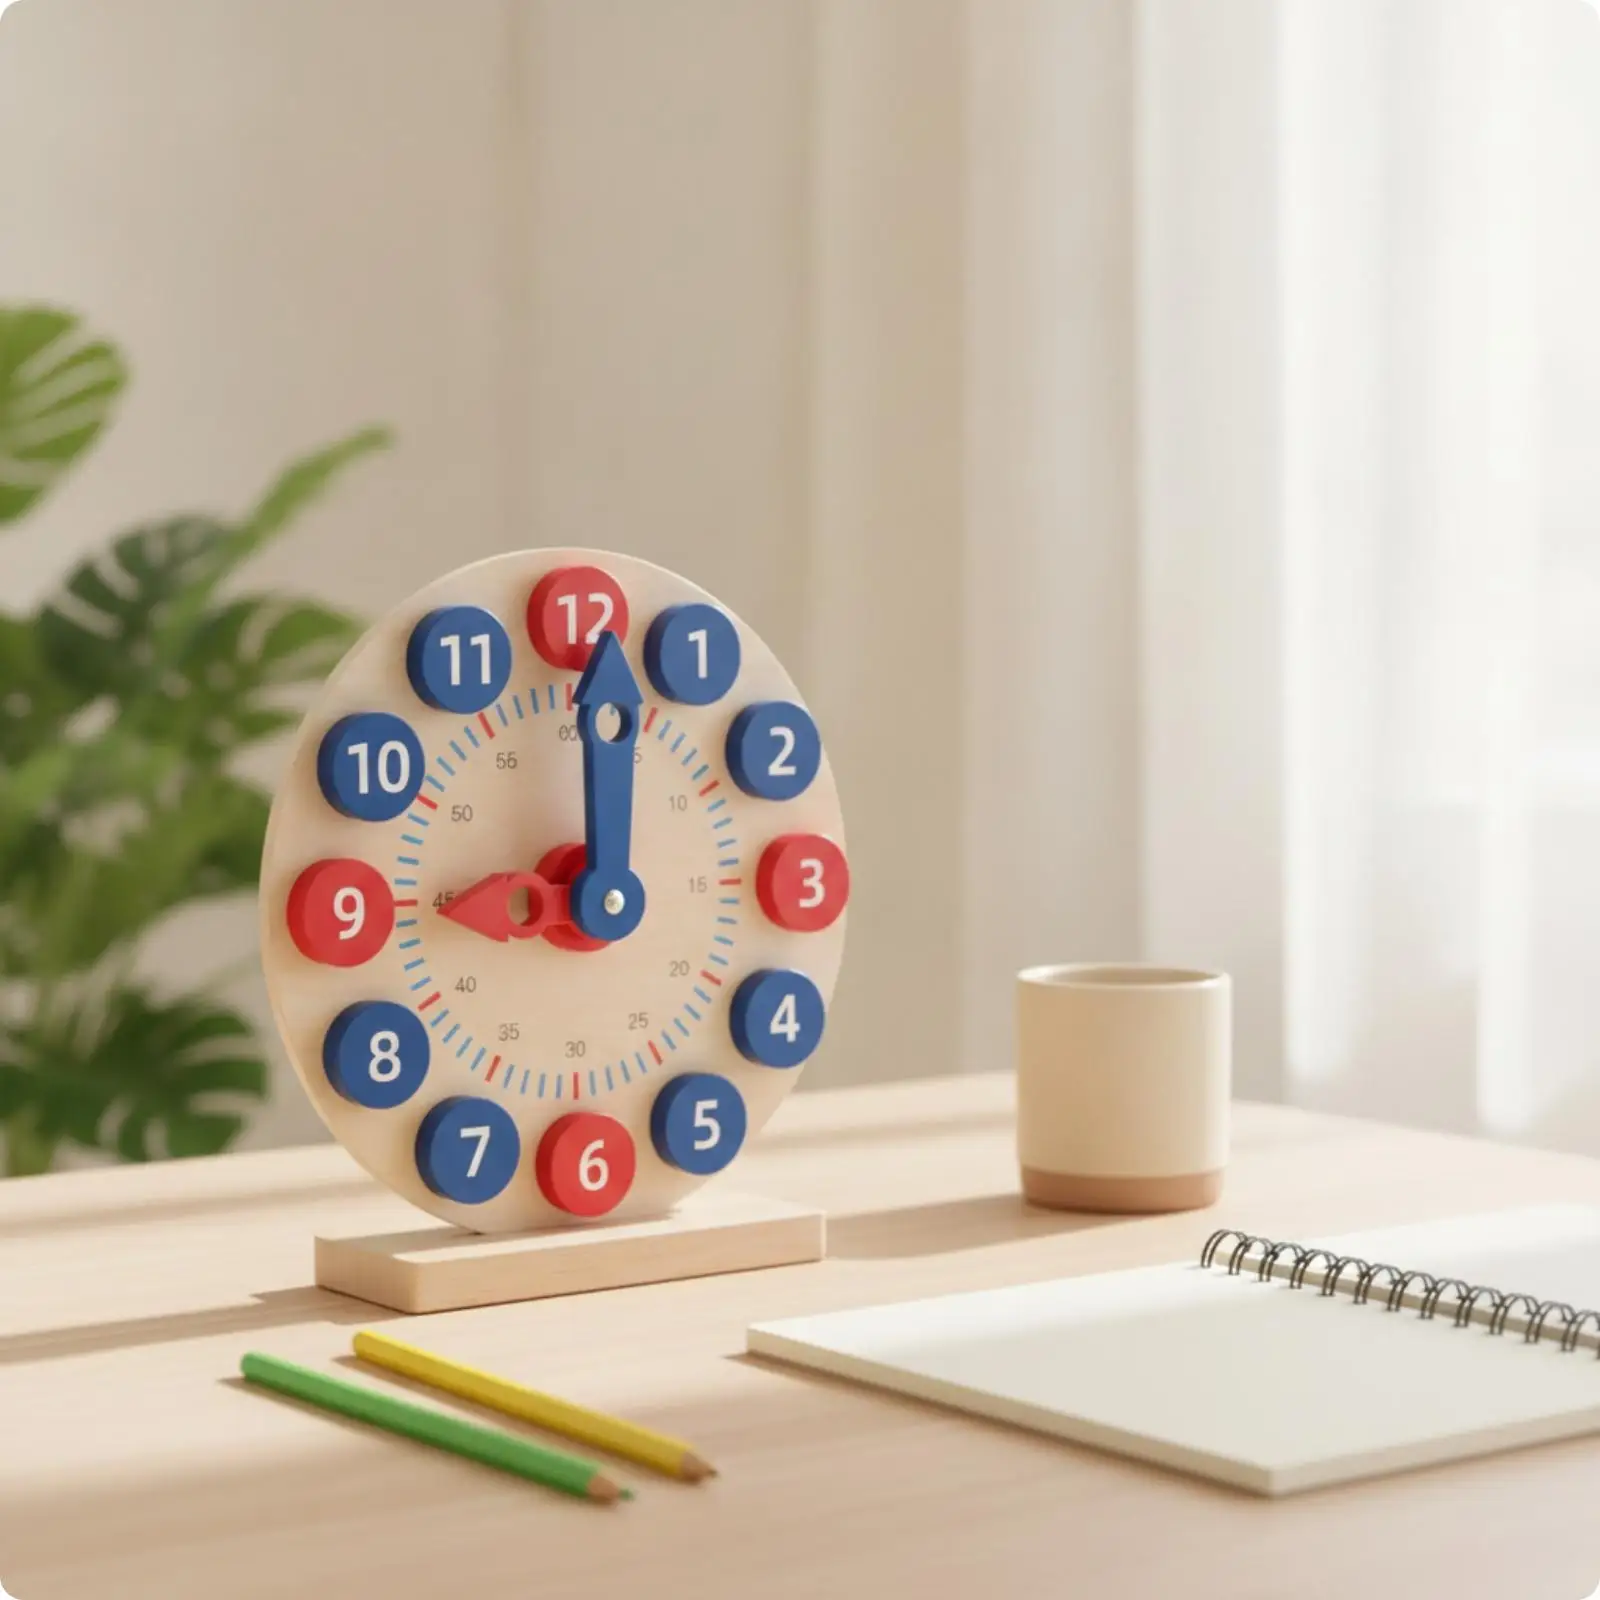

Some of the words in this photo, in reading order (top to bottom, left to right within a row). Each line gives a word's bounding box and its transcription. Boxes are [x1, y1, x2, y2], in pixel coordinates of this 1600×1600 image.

[557, 592, 614, 645] 12
[440, 633, 491, 686] 11
[687, 629, 708, 679] 1
[347, 740, 410, 795] 10
[767, 726, 797, 777] 2
[451, 804, 473, 823] 50
[668, 794, 688, 812] 10
[687, 875, 708, 893] 15
[799, 858, 825, 908] 3
[333, 887, 365, 940] 9
[455, 975, 477, 994] 40
[669, 960, 690, 978] 20
[498, 1022, 520, 1042] 35
[628, 1011, 649, 1030] 25
[769, 993, 801, 1043] 4
[368, 1030, 401, 1083] 8
[565, 1040, 586, 1059] 30
[693, 1099, 721, 1151] 5
[460, 1125, 491, 1178] 7
[579, 1139, 609, 1191] 6
